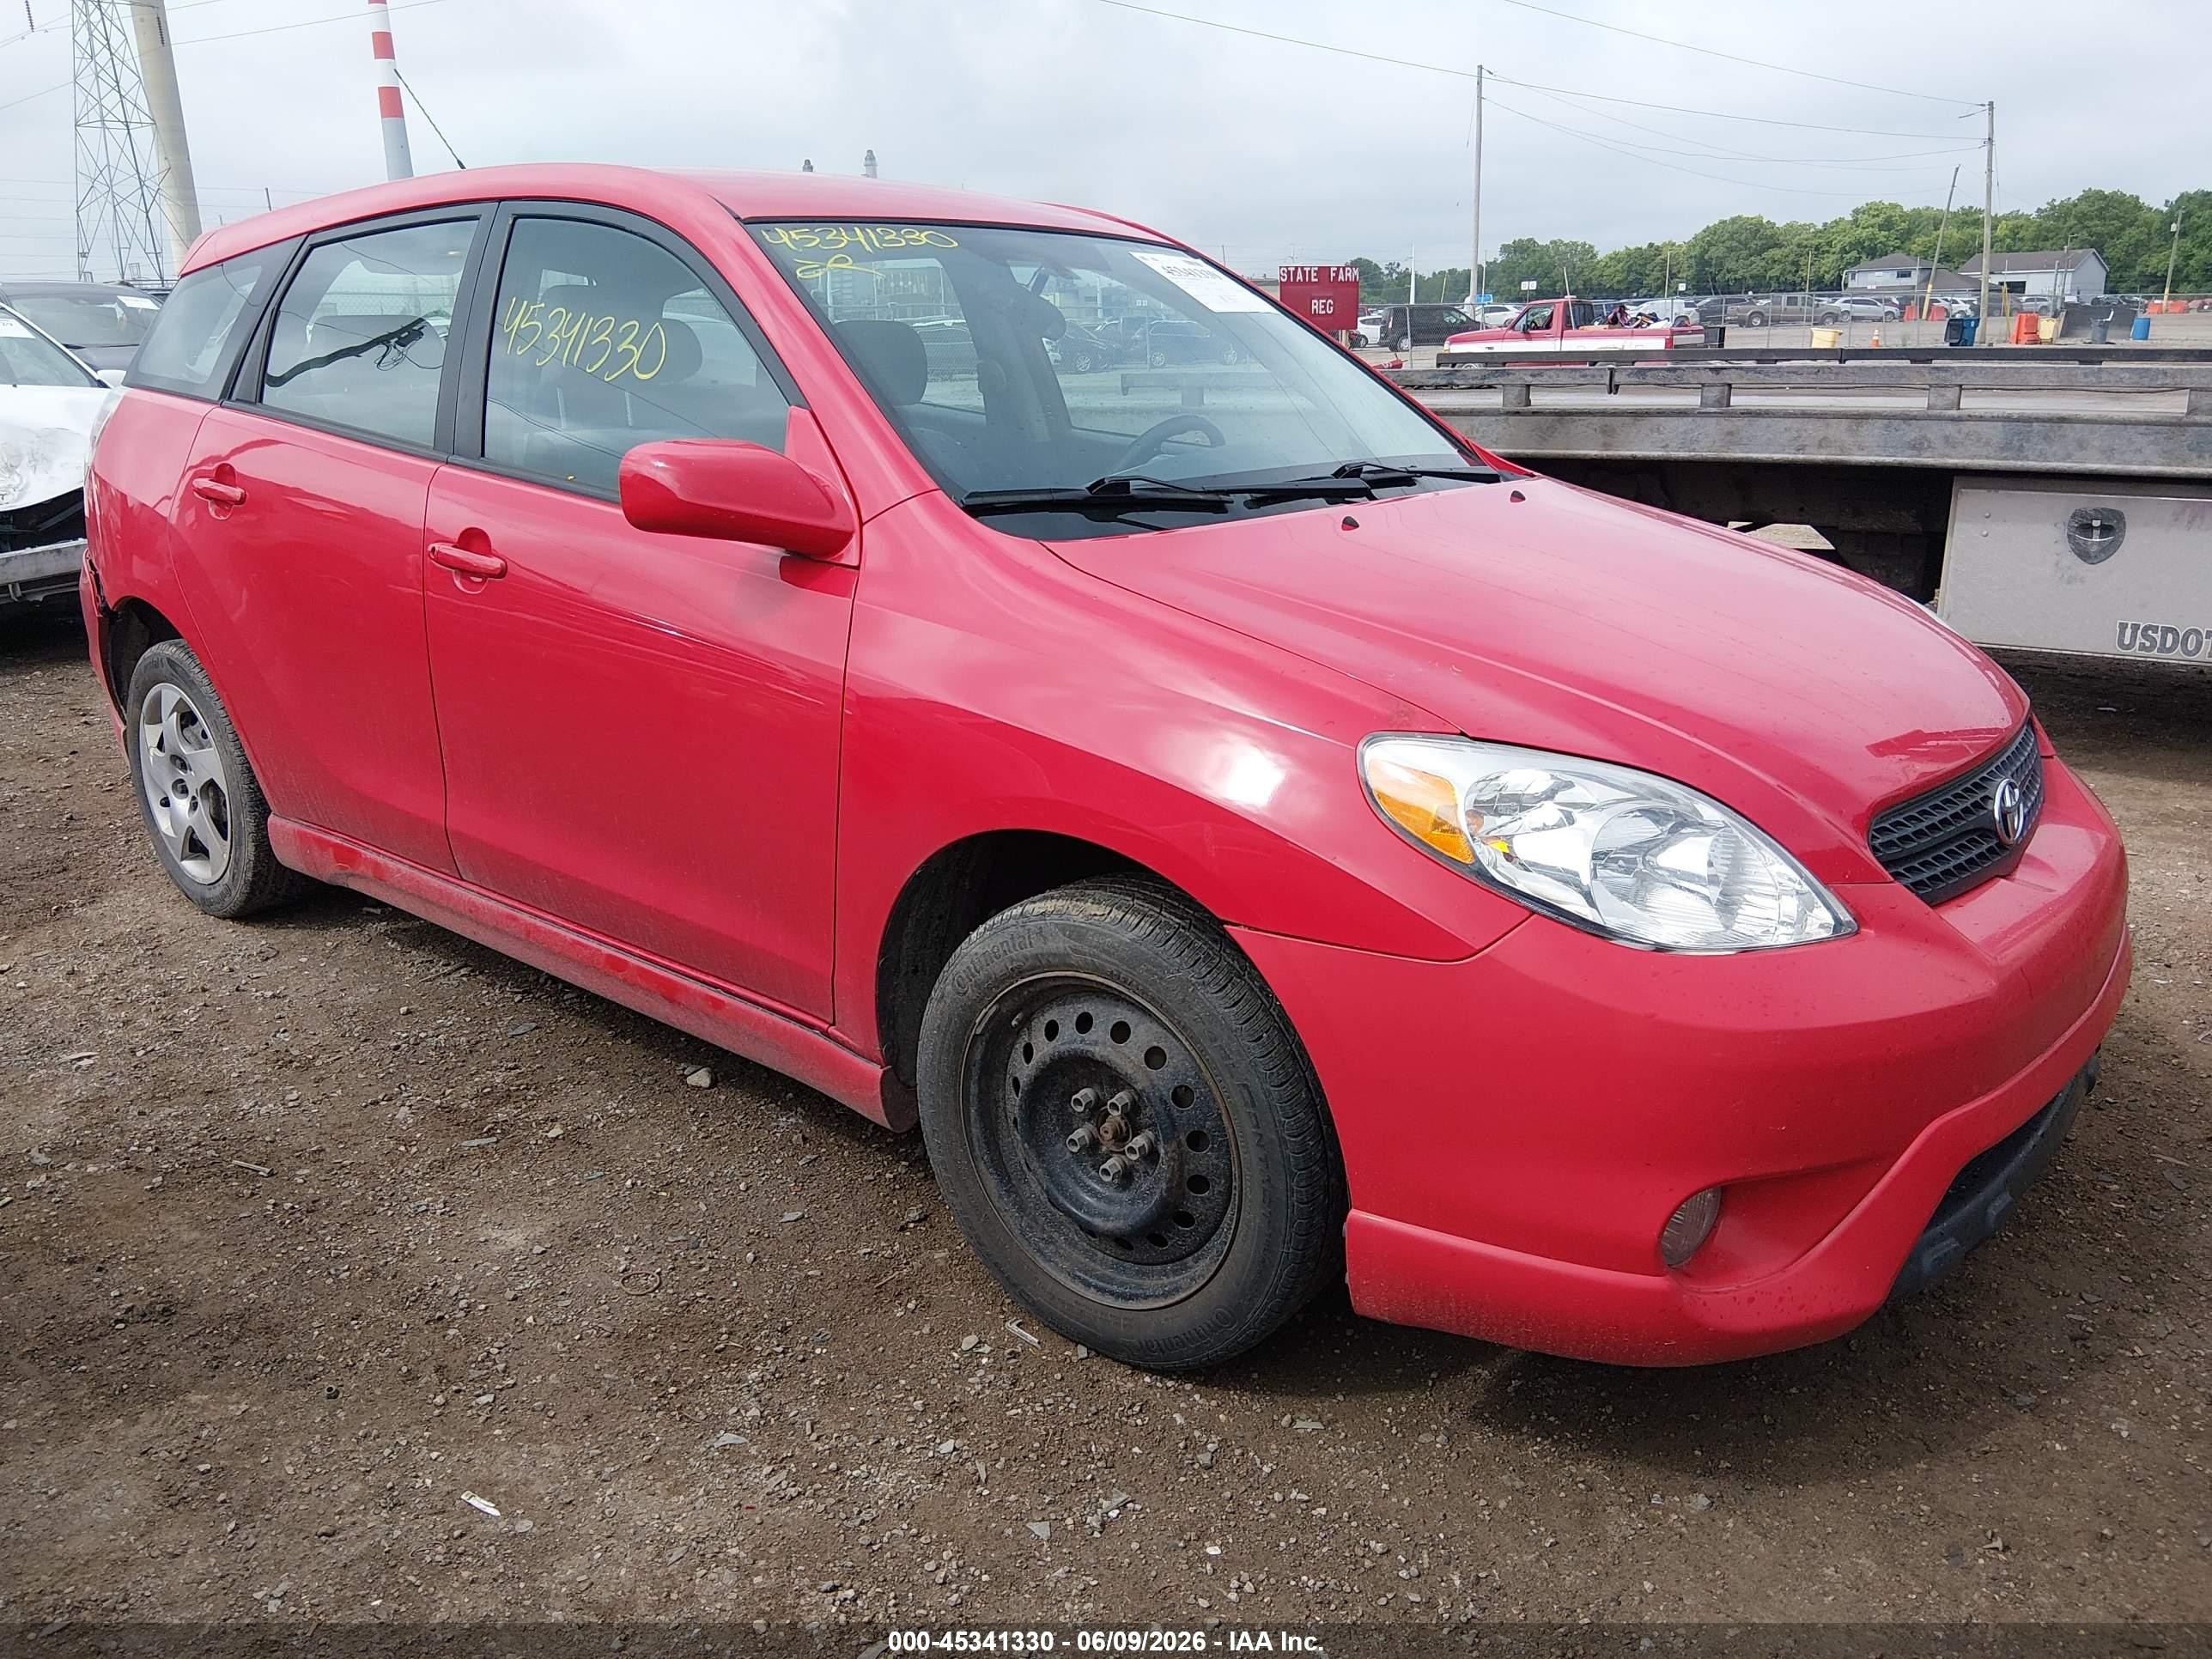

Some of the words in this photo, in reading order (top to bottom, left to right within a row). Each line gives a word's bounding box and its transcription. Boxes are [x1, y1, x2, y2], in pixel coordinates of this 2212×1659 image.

[761, 227, 959, 254] 45341330
[1279, 267, 1318, 283] STATE
[1330, 267, 1359, 283] FARM
[1311, 299, 1334, 314] REG
[503, 296, 666, 382] 45341330
